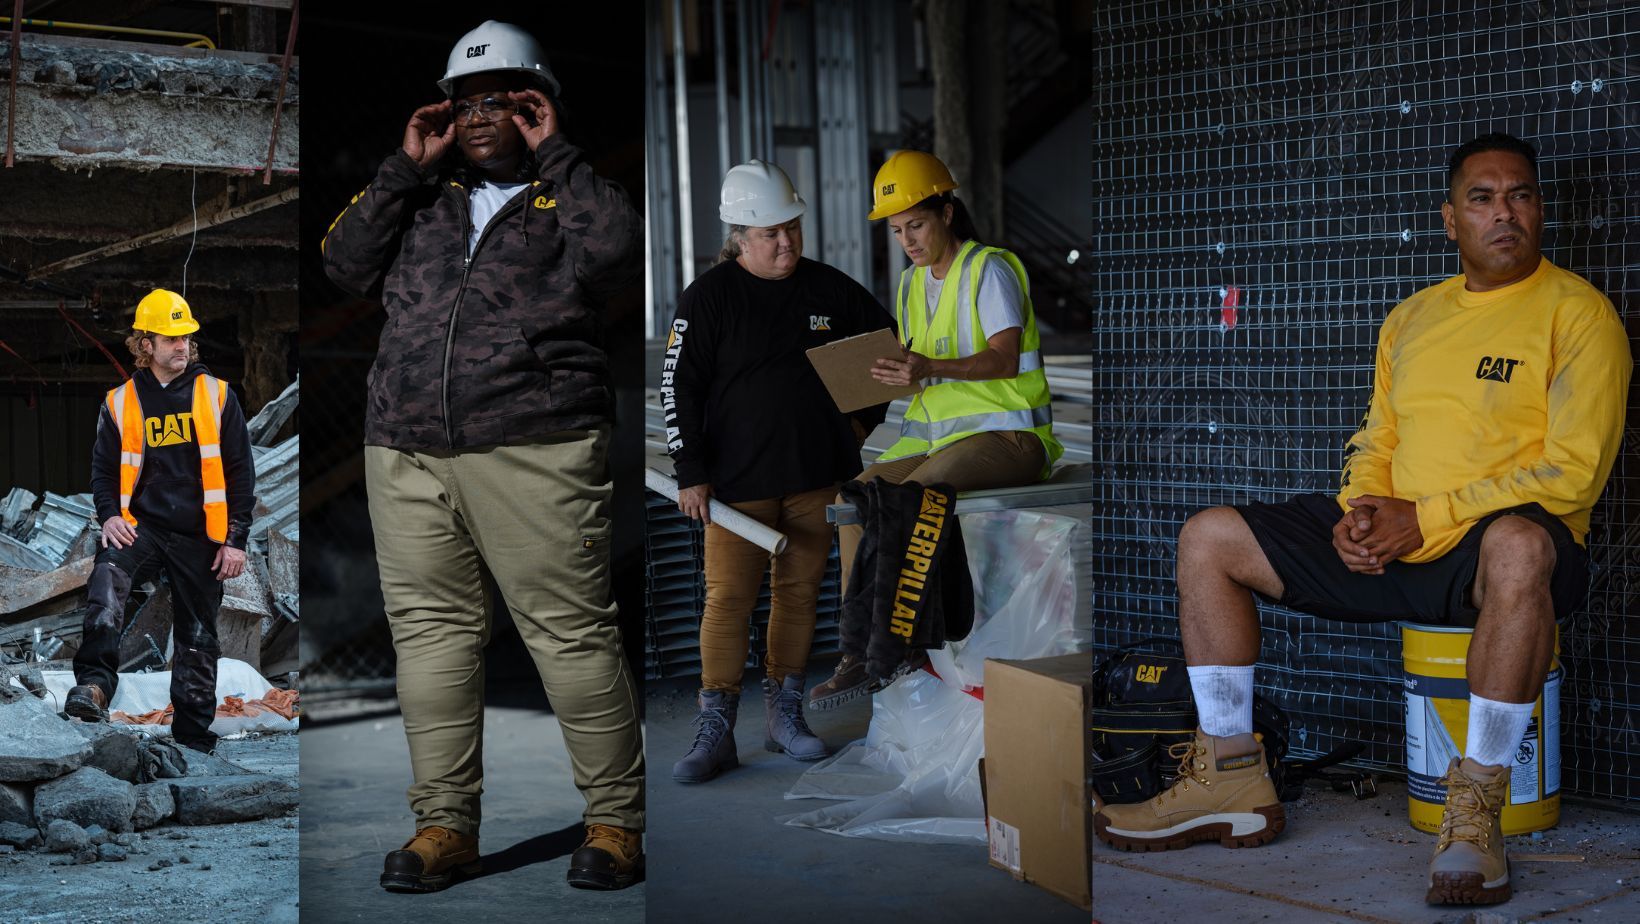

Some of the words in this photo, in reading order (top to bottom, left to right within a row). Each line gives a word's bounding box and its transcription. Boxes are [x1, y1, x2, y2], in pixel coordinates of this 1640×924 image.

[466, 43, 488, 59] CAT
[882, 183, 897, 196] CAT
[171, 311, 183, 321] CAT
[809, 315, 832, 331] CAT
[934, 336, 951, 356] CAT
[145, 412, 194, 448] CAT
[1135, 664, 1166, 684] CAT
